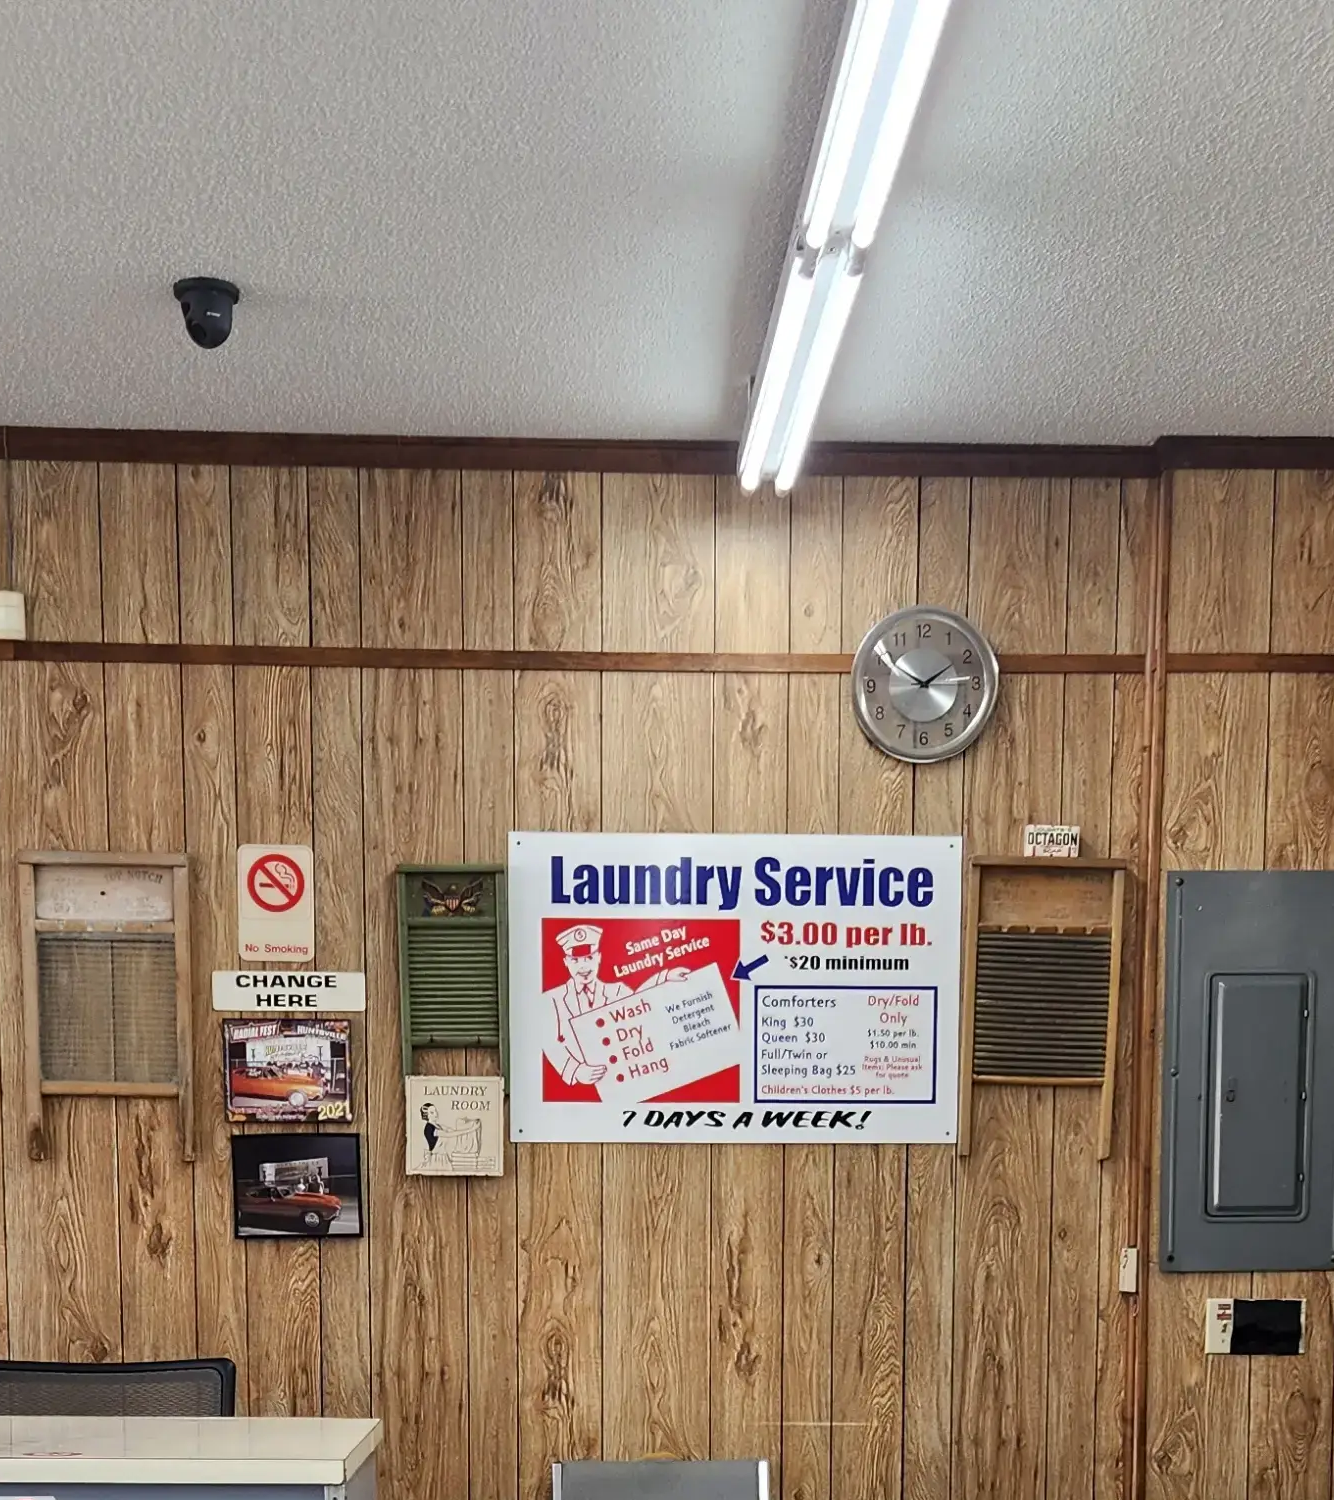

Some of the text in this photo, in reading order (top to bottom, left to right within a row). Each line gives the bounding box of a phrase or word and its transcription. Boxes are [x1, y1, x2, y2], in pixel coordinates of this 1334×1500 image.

[917, 624, 932, 638] 12
[893, 632, 906, 646] 11
[946, 632, 952, 645] 1
[962, 649, 973, 664] 2
[866, 679, 876, 693] 9
[971, 676, 981, 690] 3
[875, 706, 884, 720] 8
[963, 703, 972, 718] 4
[896, 724, 906, 738] 7
[944, 723, 954, 737] 5
[919, 732, 929, 745] 6
[1027, 832, 1078, 846] OCTAGON
[127, 869, 163, 884] NOTCH
[551, 855, 934, 911] Laundry Service
[625, 926, 687, 956] Same Day
[760, 920, 932, 948] $3.00 per lb.
[244, 943, 309, 955] No Smoking
[613, 937, 710, 978] Laundry Service
[825, 956, 910, 971] minimum
[235, 974, 337, 988] CHANGE
[256, 993, 318, 1007] HERE
[665, 990, 713, 1014] We Furnish
[762, 995, 837, 1008] Comforters
[867, 994, 920, 1009] Dry/Fold
[609, 999, 652, 1023] Wash
[672, 1004, 715, 1025] Detergent
[683, 1017, 711, 1033] Bleach
[761, 1015, 814, 1031] King $30
[879, 1012, 908, 1027] Only
[259, 1024, 277, 1036] FEST
[617, 1024, 643, 1042] Dry
[669, 1023, 732, 1051] Fabric Softener
[867, 1029, 891, 1038] $1.50
[893, 1030, 907, 1039] per
[762, 1031, 826, 1045] Queen $30
[870, 1040, 917, 1049] $10.00 min
[622, 1037, 654, 1060] Fold
[761, 1048, 828, 1060] Full/Twin or
[628, 1057, 669, 1079] Hang
[761, 1063, 856, 1079] Sleeping Bag $25
[423, 1085, 488, 1096] LAUNDRY
[761, 1084, 808, 1095] Children's
[811, 1084, 847, 1095] Clothes
[850, 1084, 861, 1096] $5
[864, 1087, 880, 1098] per
[317, 1101, 353, 1121] 2021
[450, 1100, 491, 1111] ROOM
[622, 1110, 872, 1131] 7 DAYS A WEEK!
